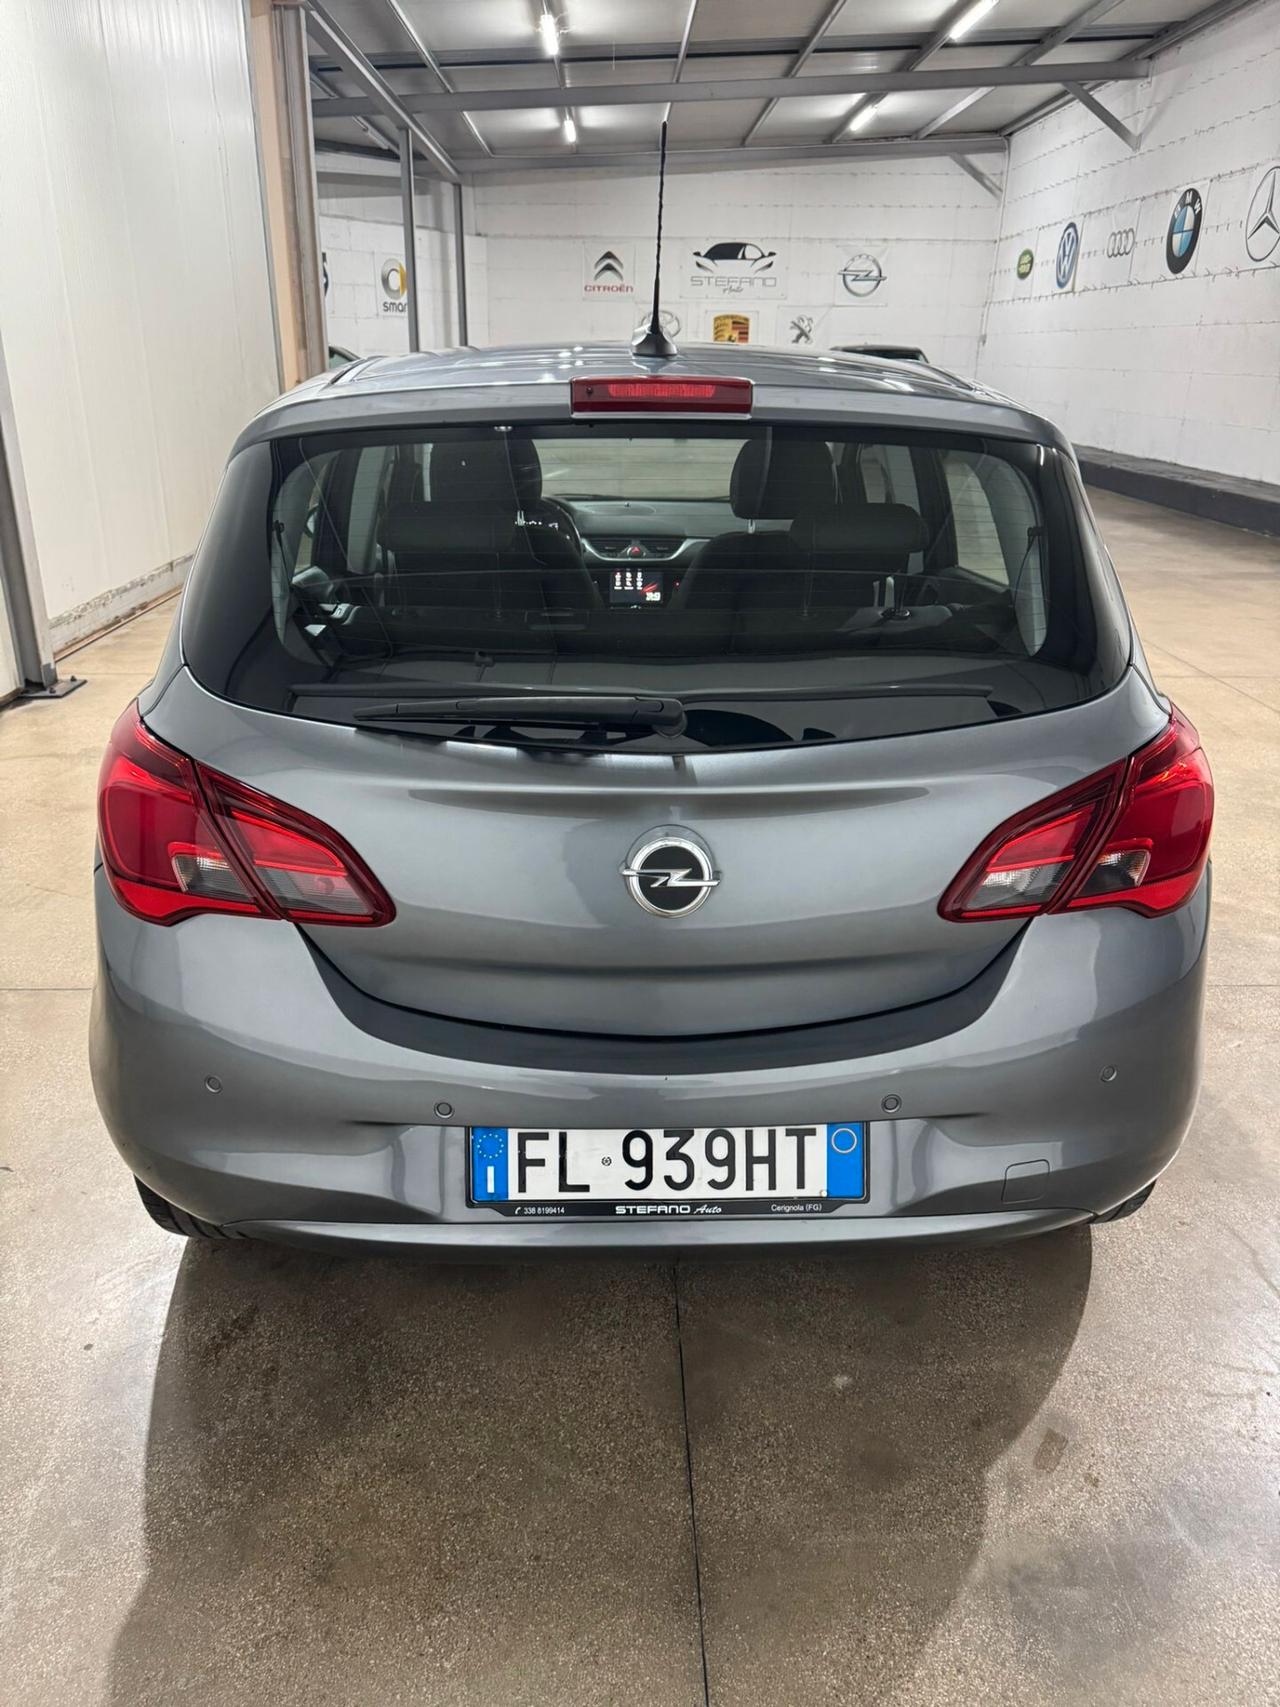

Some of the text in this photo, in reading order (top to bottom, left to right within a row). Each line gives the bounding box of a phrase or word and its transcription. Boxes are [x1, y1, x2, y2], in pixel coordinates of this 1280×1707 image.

[690, 276, 777, 287] STEFANO
[383, 301, 408, 312] smar
[518, 1129, 816, 1193] FL 939HT
[523, 1205, 565, 1215] 338 8199414
[615, 1204, 722, 1214] STEFANO Auto
[771, 1203, 822, 1213] Cerignola (FG)
